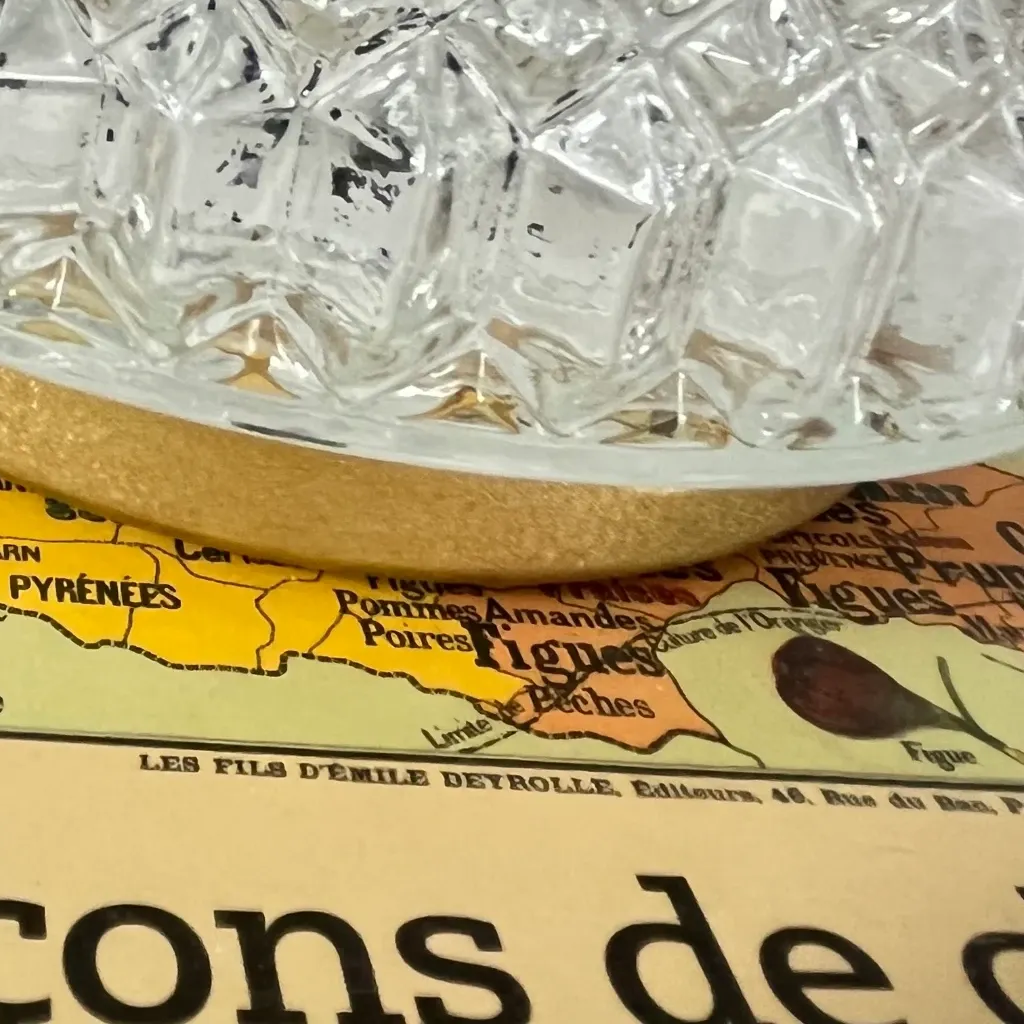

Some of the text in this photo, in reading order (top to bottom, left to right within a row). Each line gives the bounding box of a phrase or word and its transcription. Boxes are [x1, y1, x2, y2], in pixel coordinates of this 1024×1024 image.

[9, 573, 181, 610] PYRÉNÉES
[333, 588, 482, 624] Pommes
[485, 597, 656, 632] Amandes
[360, 616, 473, 652] Poires
[459, 618, 668, 689] Figues
[139, 754, 200, 773] LES
[213, 757, 287, 778] FILS
[819, 787, 877, 808] Rue
[888, 791, 927, 810] du
[604, 874, 908, 1024] de
